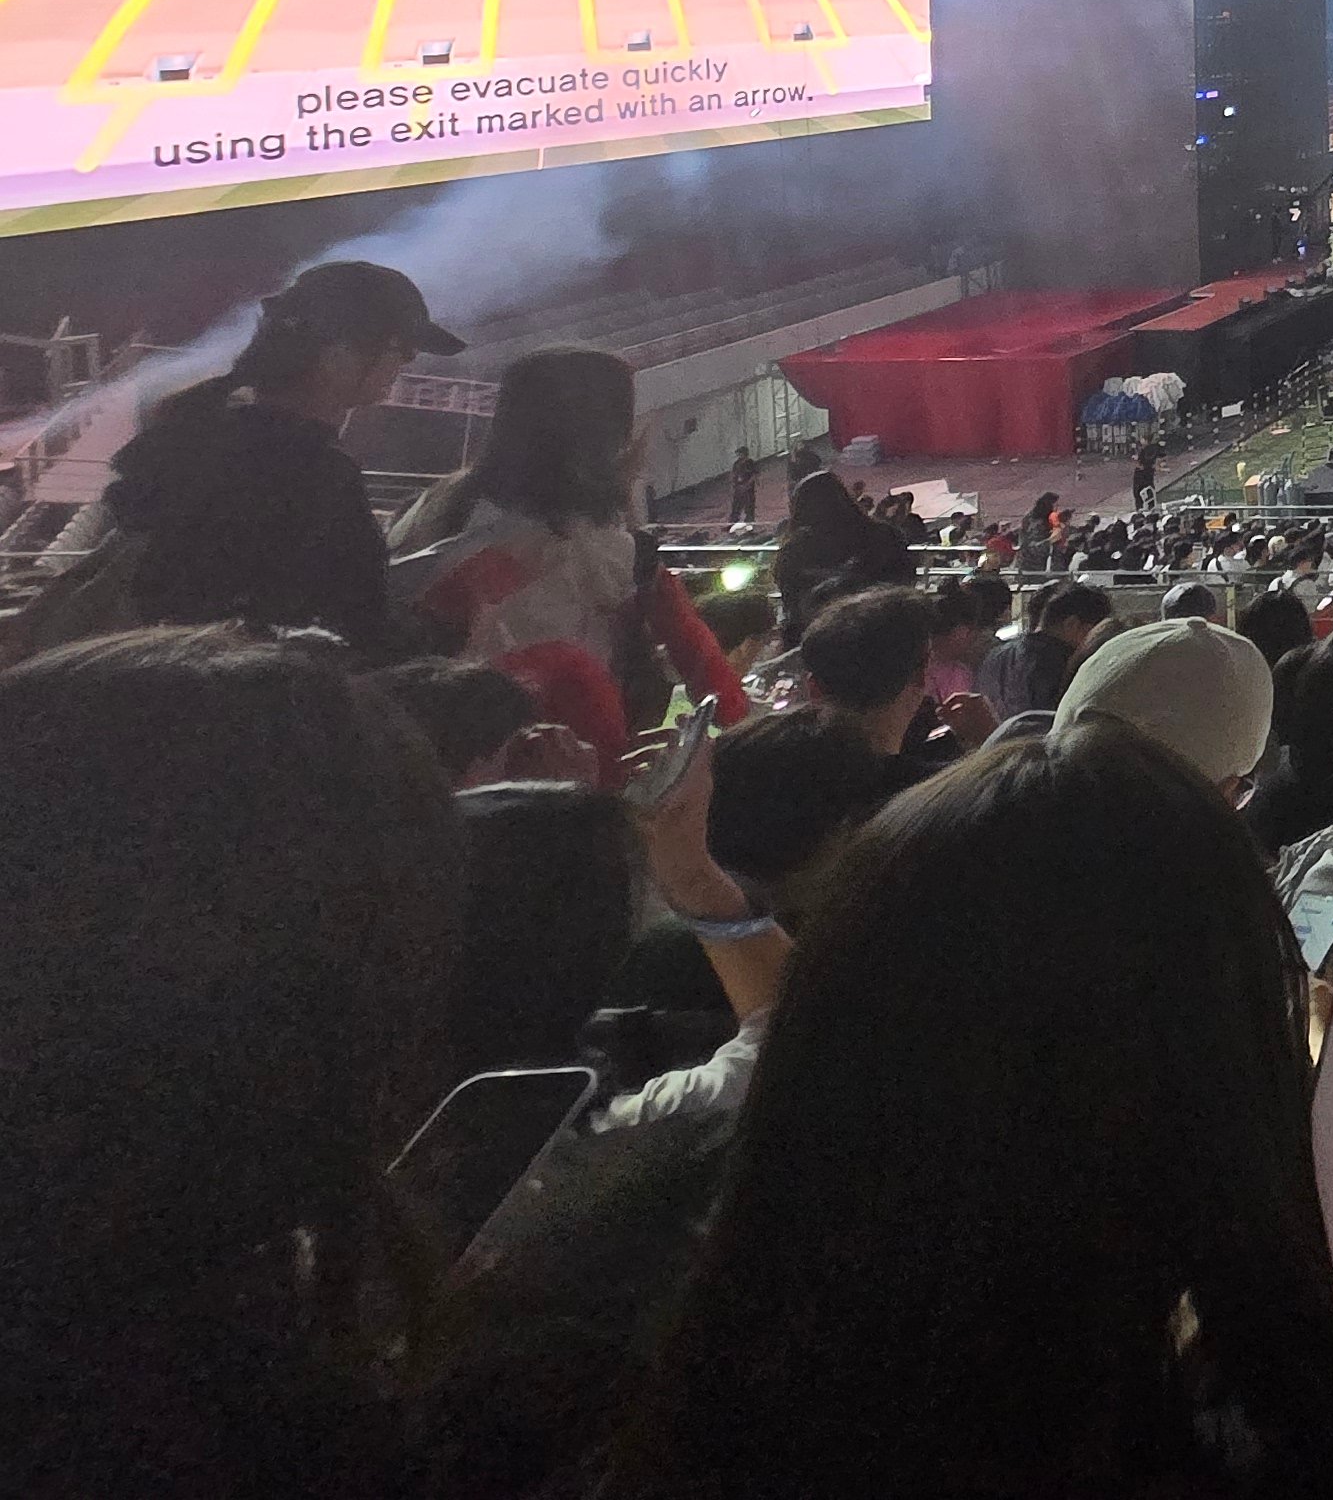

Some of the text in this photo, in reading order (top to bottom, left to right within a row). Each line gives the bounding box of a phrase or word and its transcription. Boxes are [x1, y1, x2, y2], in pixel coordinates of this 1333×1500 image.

[297, 57, 728, 119] please evacuate quickly
[153, 84, 814, 168] using the exit marked with an arrow.
